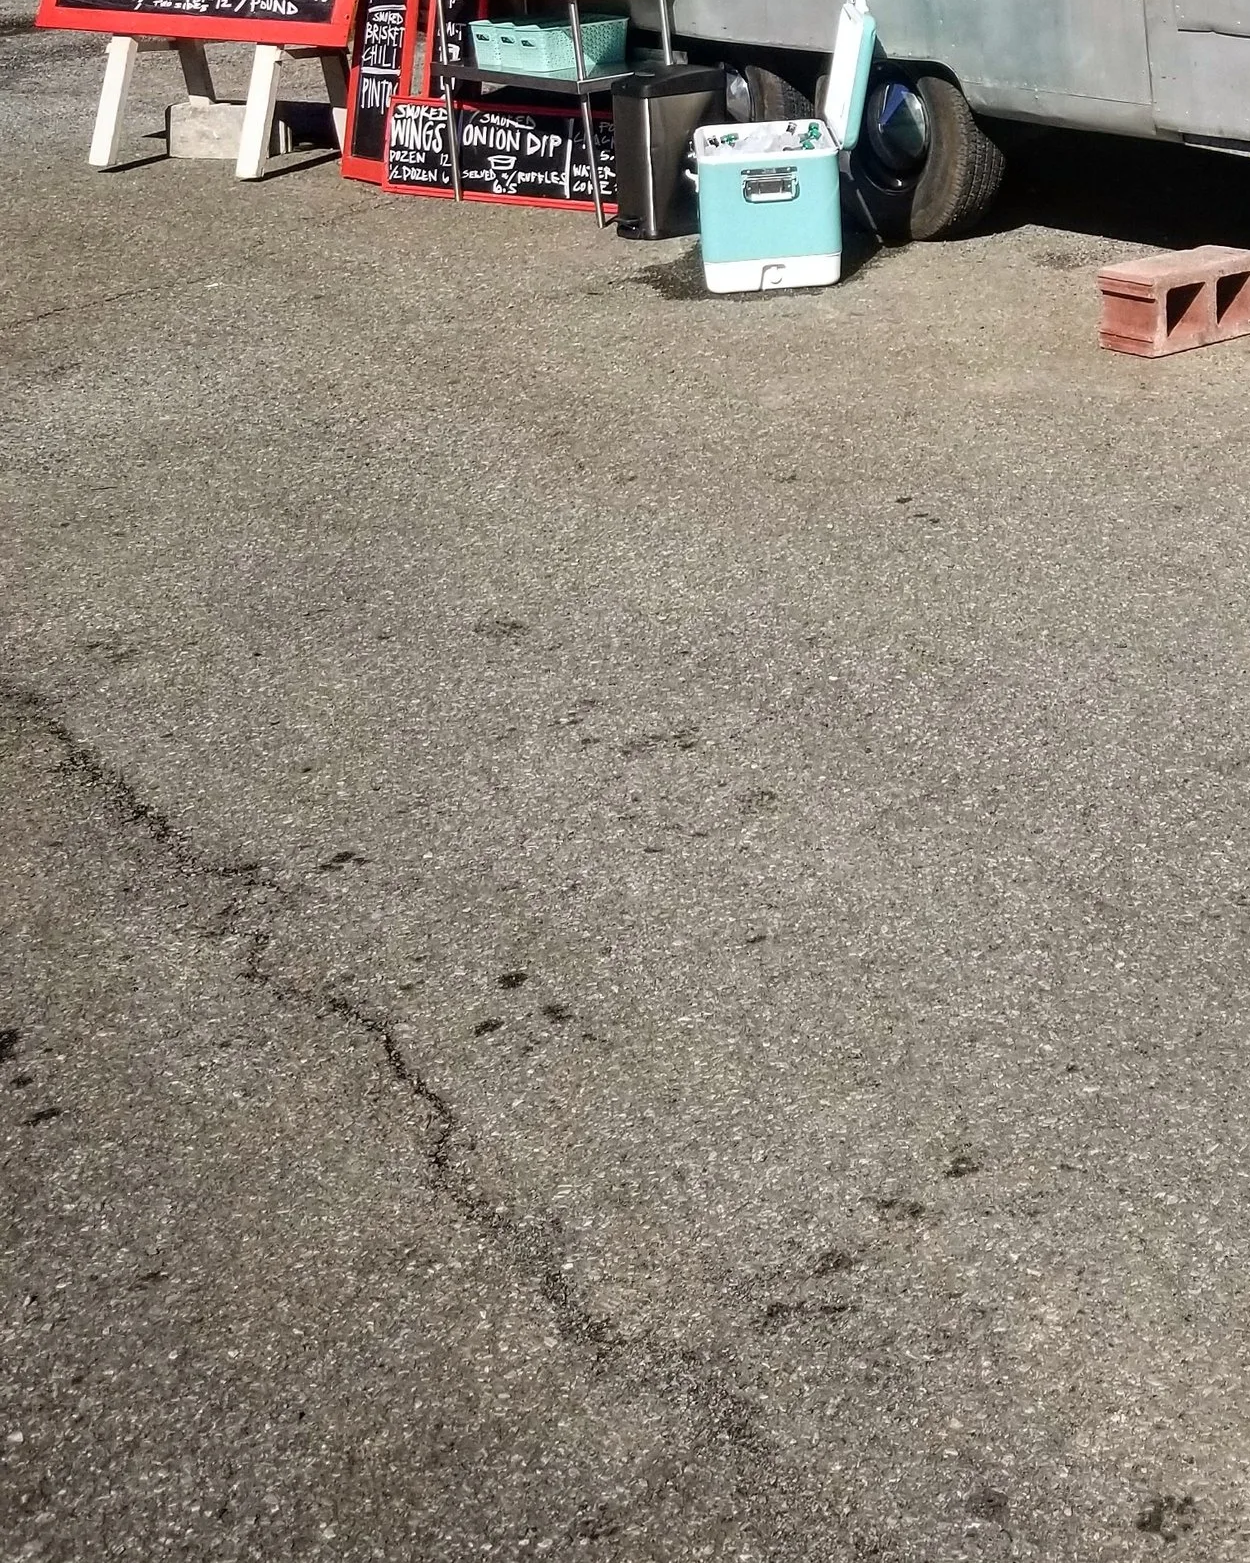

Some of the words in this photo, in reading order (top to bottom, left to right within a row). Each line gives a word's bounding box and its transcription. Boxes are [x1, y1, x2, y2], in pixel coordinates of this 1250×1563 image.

[153, 0, 172, 8] TWO
[372, 11, 404, 25] SMOKED
[365, 22, 405, 48] BRISKET
[362, 46, 397, 69] CHILI
[391, 118, 447, 154] WINGS
[463, 123, 521, 152] ONION
[526, 132, 562, 157] DIP
[389, 150, 426, 164] DOZEN
[440, 153, 452, 167] 12
[402, 165, 438, 182] DOZEN
[462, 169, 497, 181] SERVED
[517, 171, 566, 186] RUFFLES
[493, 179, 518, 194] 6.5
